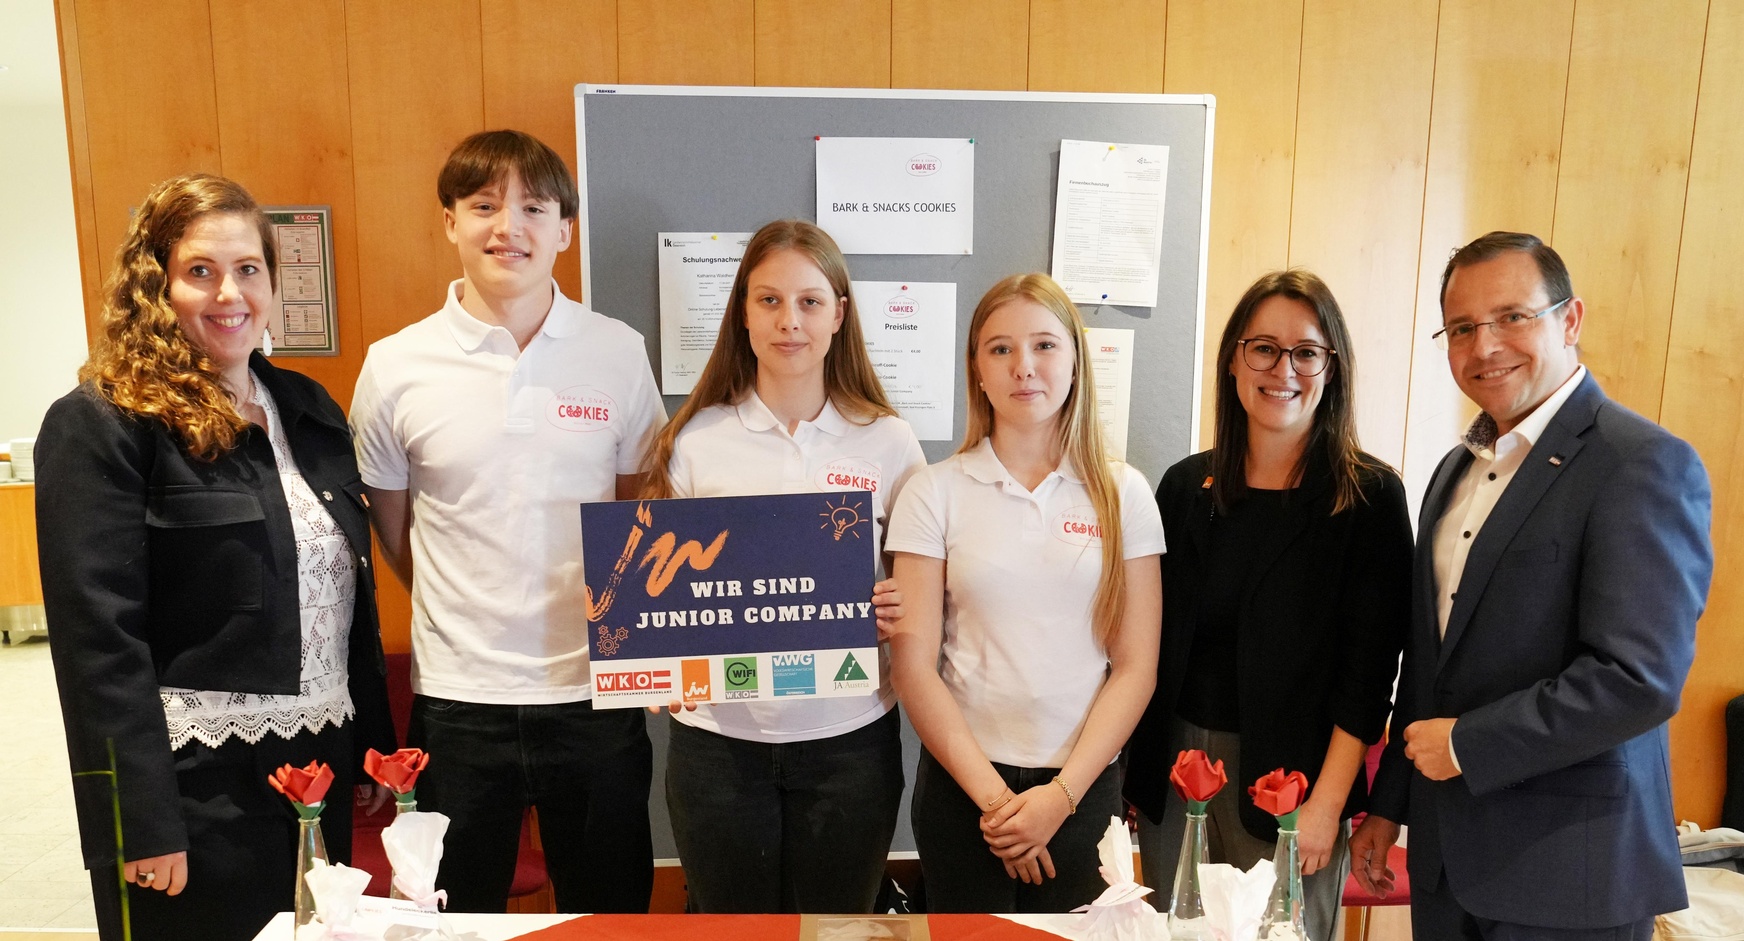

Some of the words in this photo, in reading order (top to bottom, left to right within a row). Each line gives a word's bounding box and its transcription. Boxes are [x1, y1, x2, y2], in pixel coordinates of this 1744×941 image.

[911, 163, 936, 171] COOKIES
[832, 203, 859, 213] BARK
[862, 203, 870, 213] &
[873, 202, 911, 213] SNACKS
[913, 202, 957, 213] COOKIES
[682, 256, 742, 264] Schulungsnachwe
[888, 305, 914, 313] COOKIES
[884, 323, 918, 331] Preisliste
[588, 398, 612, 406] SNACK
[558, 405, 609, 422] COOKIES
[827, 473, 877, 493] COOKIES
[1063, 521, 1103, 539] COOKI
[690, 579, 743, 599] WIR
[752, 576, 816, 596] SIND
[636, 608, 734, 629] JUNIOR
[743, 600, 872, 624] COMPANY
[732, 669, 756, 679] WIFI
[597, 673, 650, 690] WKO
[833, 681, 843, 691] JA
[845, 681, 870, 689] Austria
[725, 691, 749, 699] WKO
